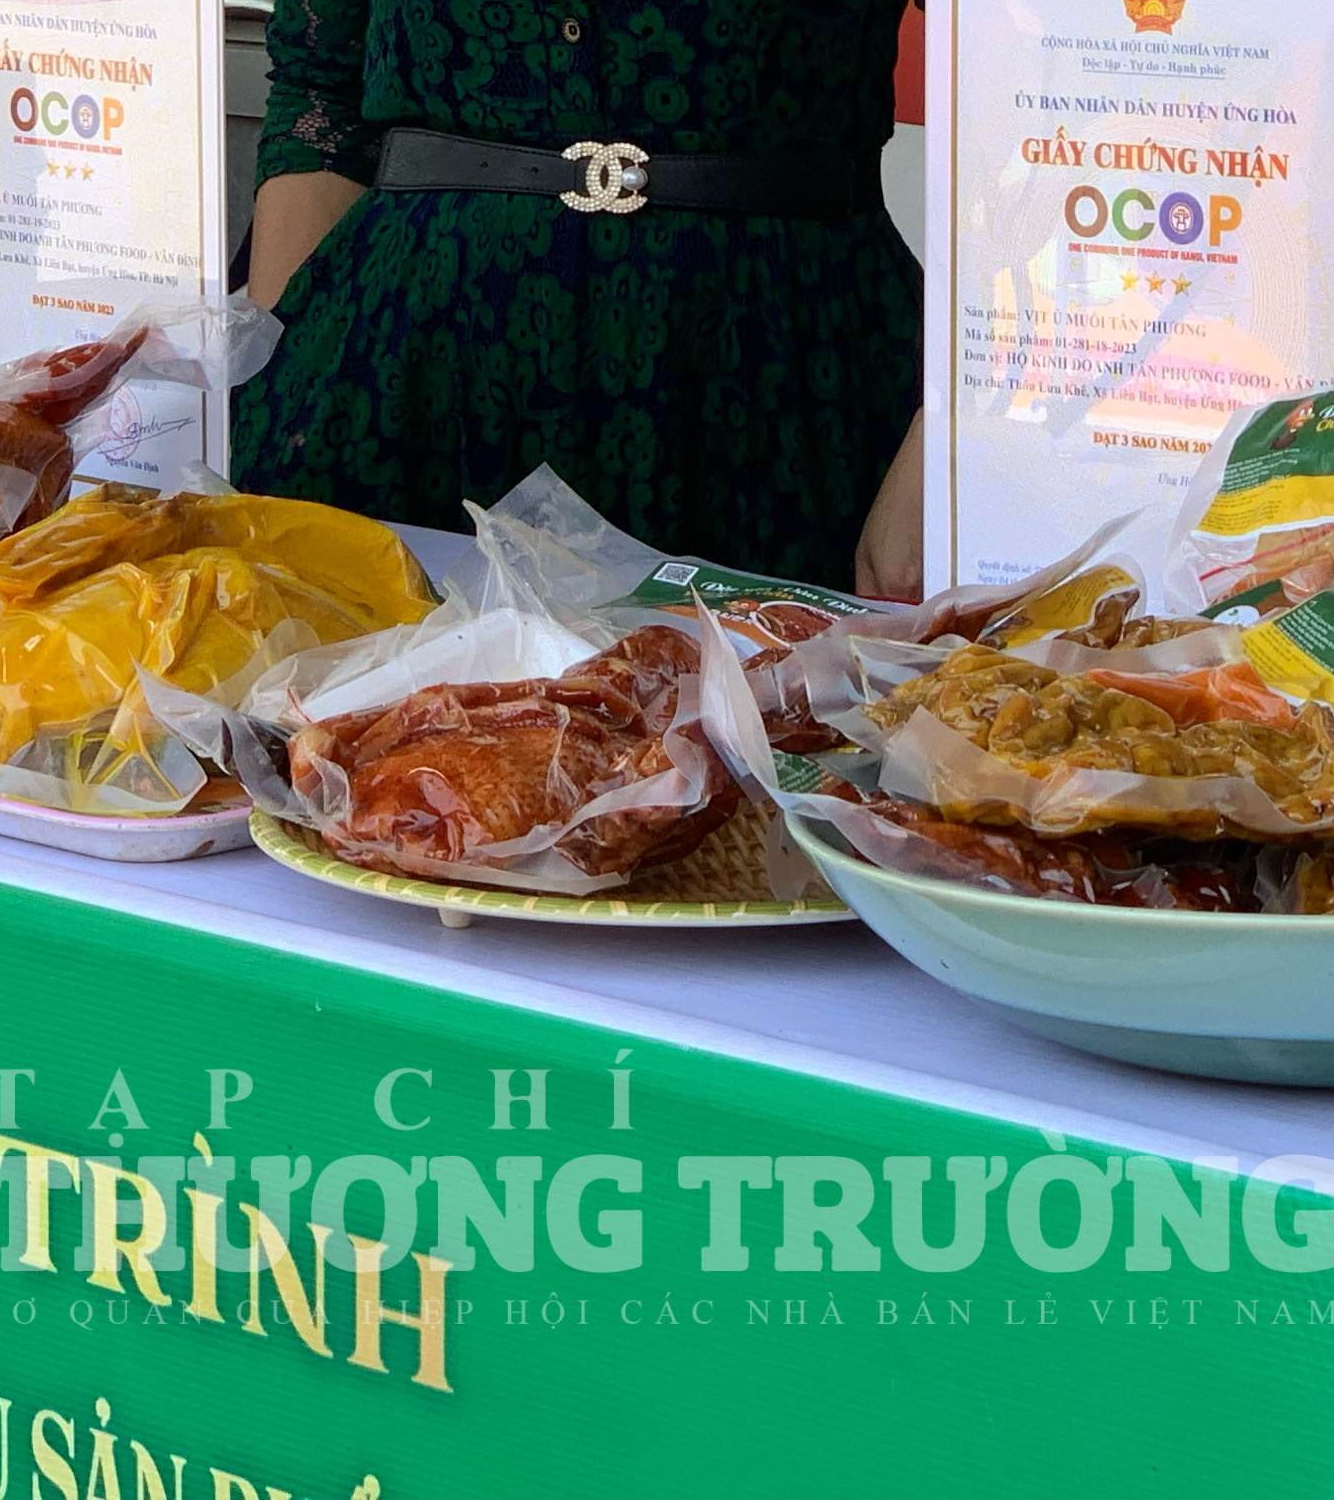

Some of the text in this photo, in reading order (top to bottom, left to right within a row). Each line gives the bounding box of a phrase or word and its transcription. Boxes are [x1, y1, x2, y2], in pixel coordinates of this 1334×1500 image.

[28, 48, 95, 80] CHỨNG
[99, 56, 153, 92] NHẬN
[10, 87, 125, 141] OCOP
[1014, 93, 1297, 125] ỦY BAN NHÂN DÂN HUYỆN ỨNG HÒA
[1021, 124, 1290, 189] GIẤY CHỨNG NHẬN
[1064, 185, 1243, 247] OCOP
[1025, 310, 1047, 324] VỊT
[1111, 315, 1138, 332] TÂN
[1143, 320, 1207, 341] PHƯƠNG
[1055, 337, 1137, 354] 01-281-18-2023
[1007, 352, 1027, 368] HỘ
[1032, 356, 1068, 370] KINH
[1072, 358, 1123, 375] DOANH
[1128, 360, 1157, 378] TÂN
[1162, 365, 1225, 384] PHƯƠNG
[1231, 373, 1271, 388] FOOD
[1093, 431, 1118, 448] ĐẠT
[1121, 434, 1129, 446] 3
[1132, 435, 1157, 449] SAO
[1161, 435, 1189, 453] NĂM
